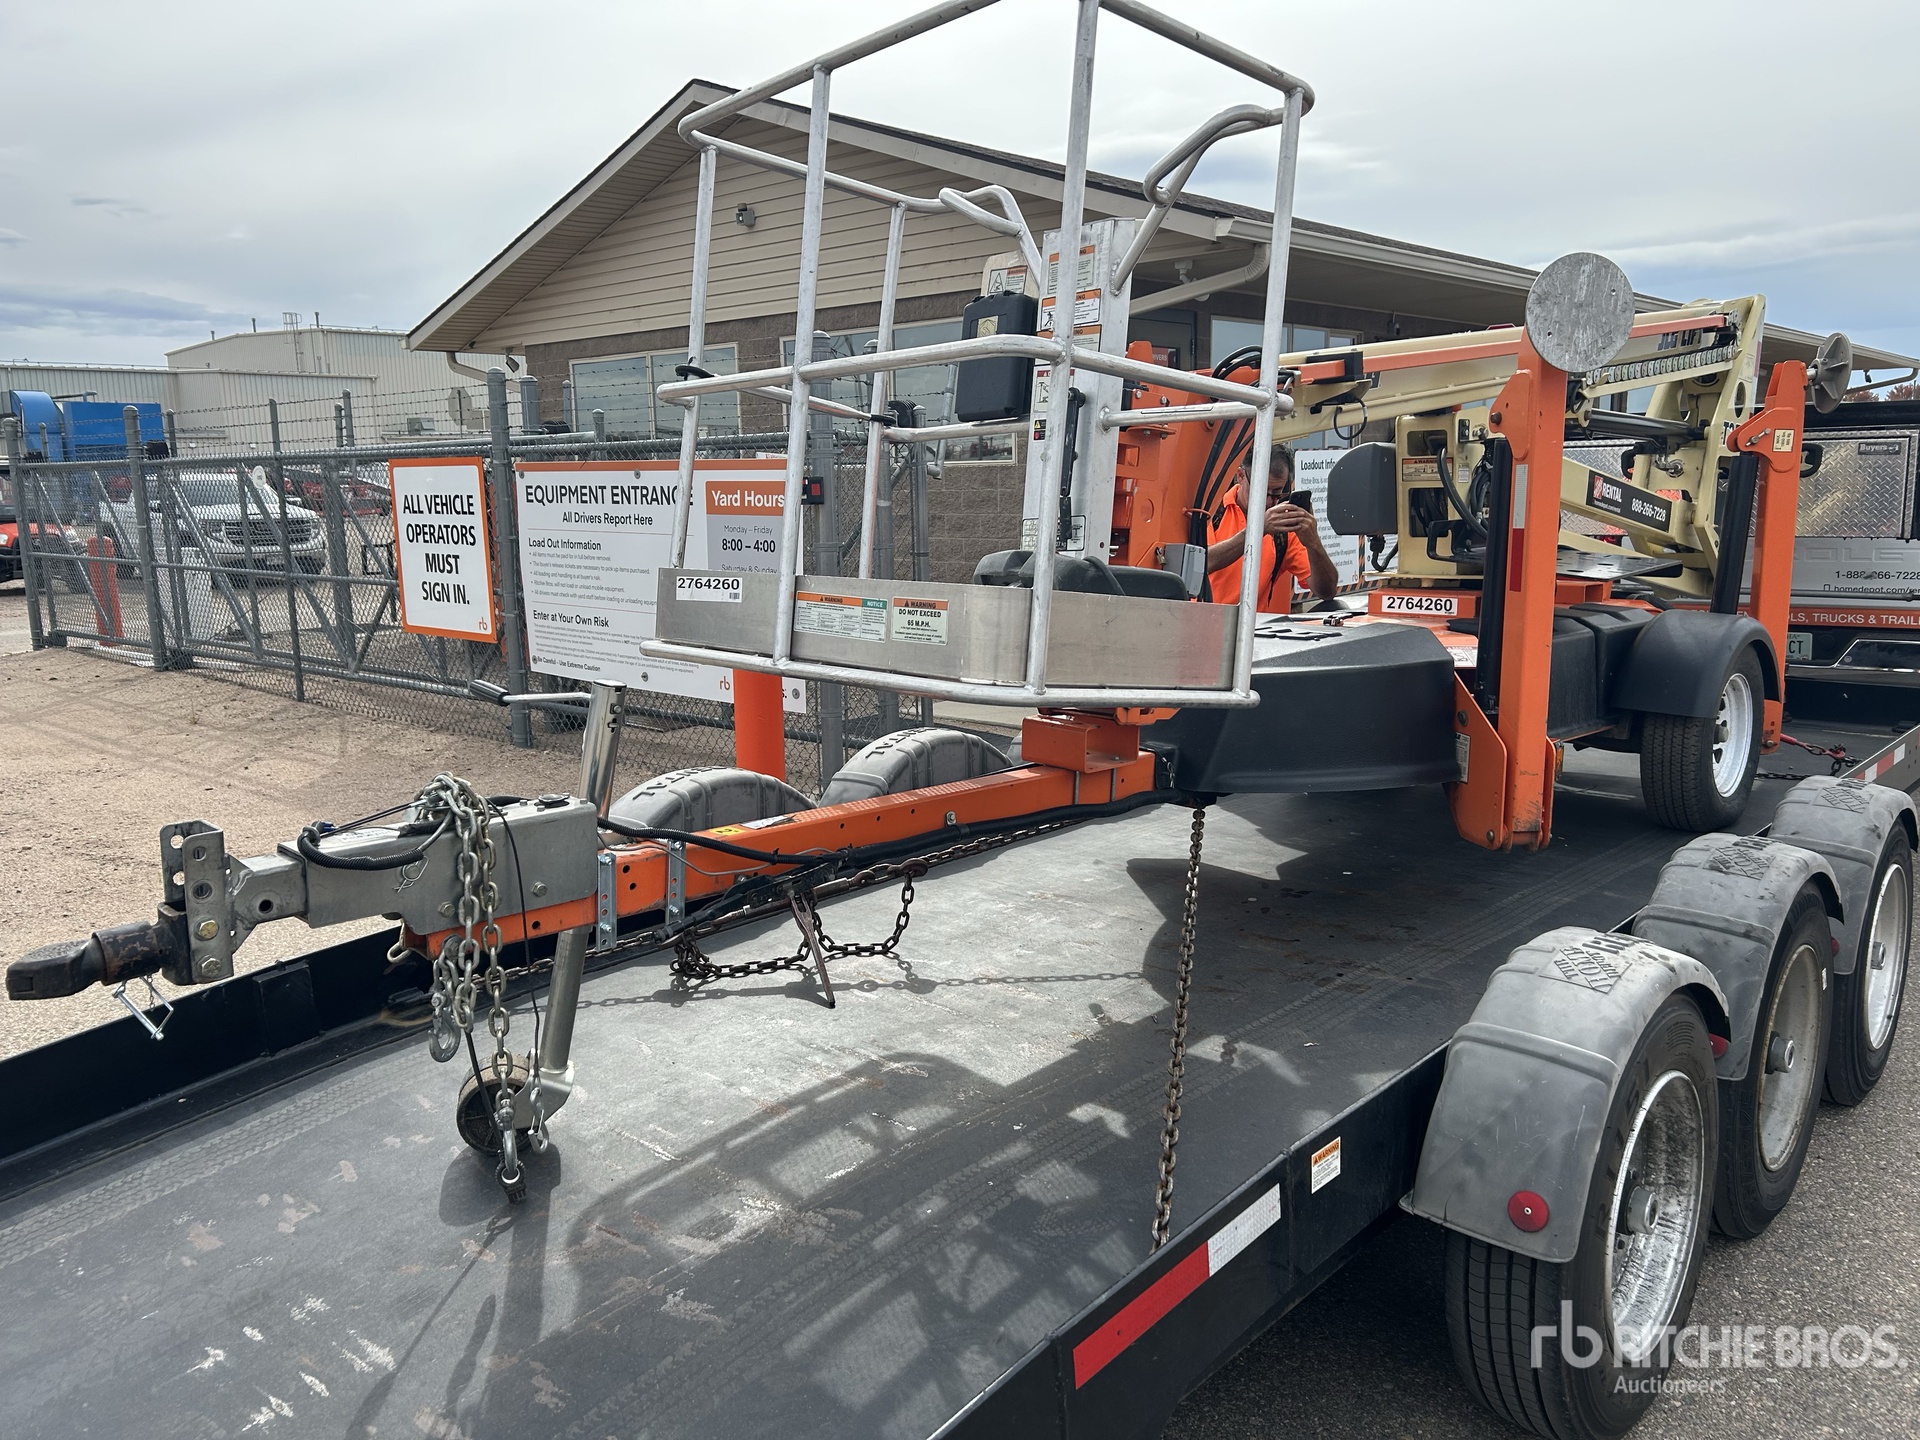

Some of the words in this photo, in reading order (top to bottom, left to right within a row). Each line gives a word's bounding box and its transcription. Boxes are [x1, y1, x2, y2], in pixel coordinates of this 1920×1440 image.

[1860, 444, 1888, 452] Buyers
[1301, 460, 1324, 470] Loadout
[525, 485, 606, 506] EQUIPMENT
[712, 490, 740, 506] Yard
[744, 491, 785, 507] Hours
[1602, 483, 1622, 502] RENTAL
[403, 495, 424, 514] ALL
[425, 495, 475, 515] VEHICLE
[1632, 498, 1666, 522] 888-266-7228
[562, 511, 572, 522] All
[574, 512, 602, 524] Drivers
[604, 513, 632, 527] Report
[634, 514, 653, 526] Here
[406, 523, 476, 546] OPERATORS
[724, 525, 747, 535] Monday
[754, 526, 773, 535] Friday
[529, 538, 545, 548] Load
[547, 539, 560, 548] Out
[561, 539, 601, 550] Information
[722, 538, 742, 551] 8:00
[753, 540, 776, 552] 4:00
[425, 553, 460, 574] MUST
[677, 577, 740, 590] 2764260
[421, 581, 450, 603] SIGN
[453, 584, 470, 605] IN.
[1386, 596, 1453, 612] 2764260
[479, 617, 488, 630] rb
[533, 610, 549, 621] Enter
[558, 613, 573, 624] Your
[575, 615, 592, 625] Own
[594, 617, 609, 627] Risk
[1812, 613, 1864, 624] TRUCKS
[1868, 615, 1876, 624] &
[1880, 615, 1920, 625] TRAIL
[567, 661, 583, 669] Extreme
[720, 676, 730, 690] rb
[1319, 1142, 1339, 1161] WARNING
